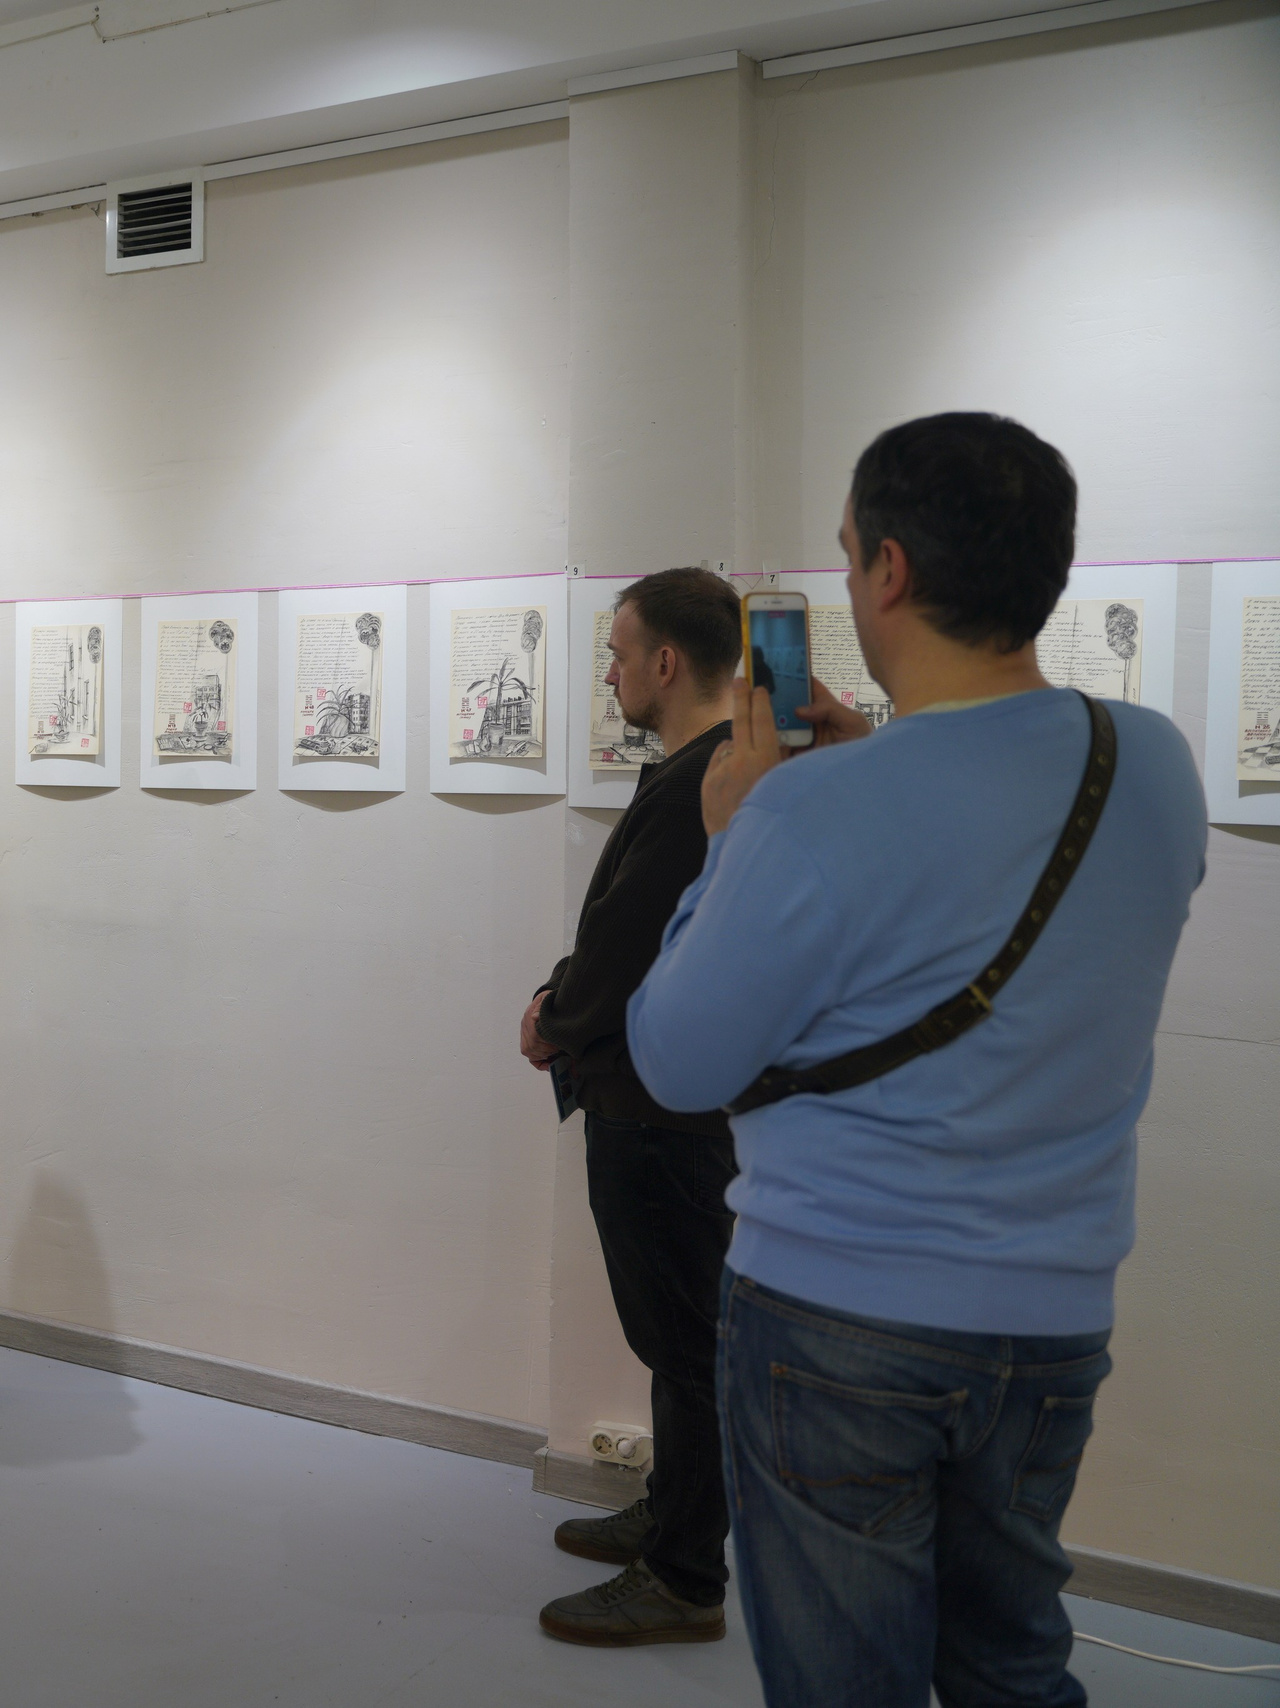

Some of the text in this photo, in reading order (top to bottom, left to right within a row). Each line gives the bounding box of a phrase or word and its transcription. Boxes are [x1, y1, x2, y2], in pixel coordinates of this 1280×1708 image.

[719, 562, 724, 571] 8
[573, 567, 578, 575] 9
[770, 575, 775, 583] 7
